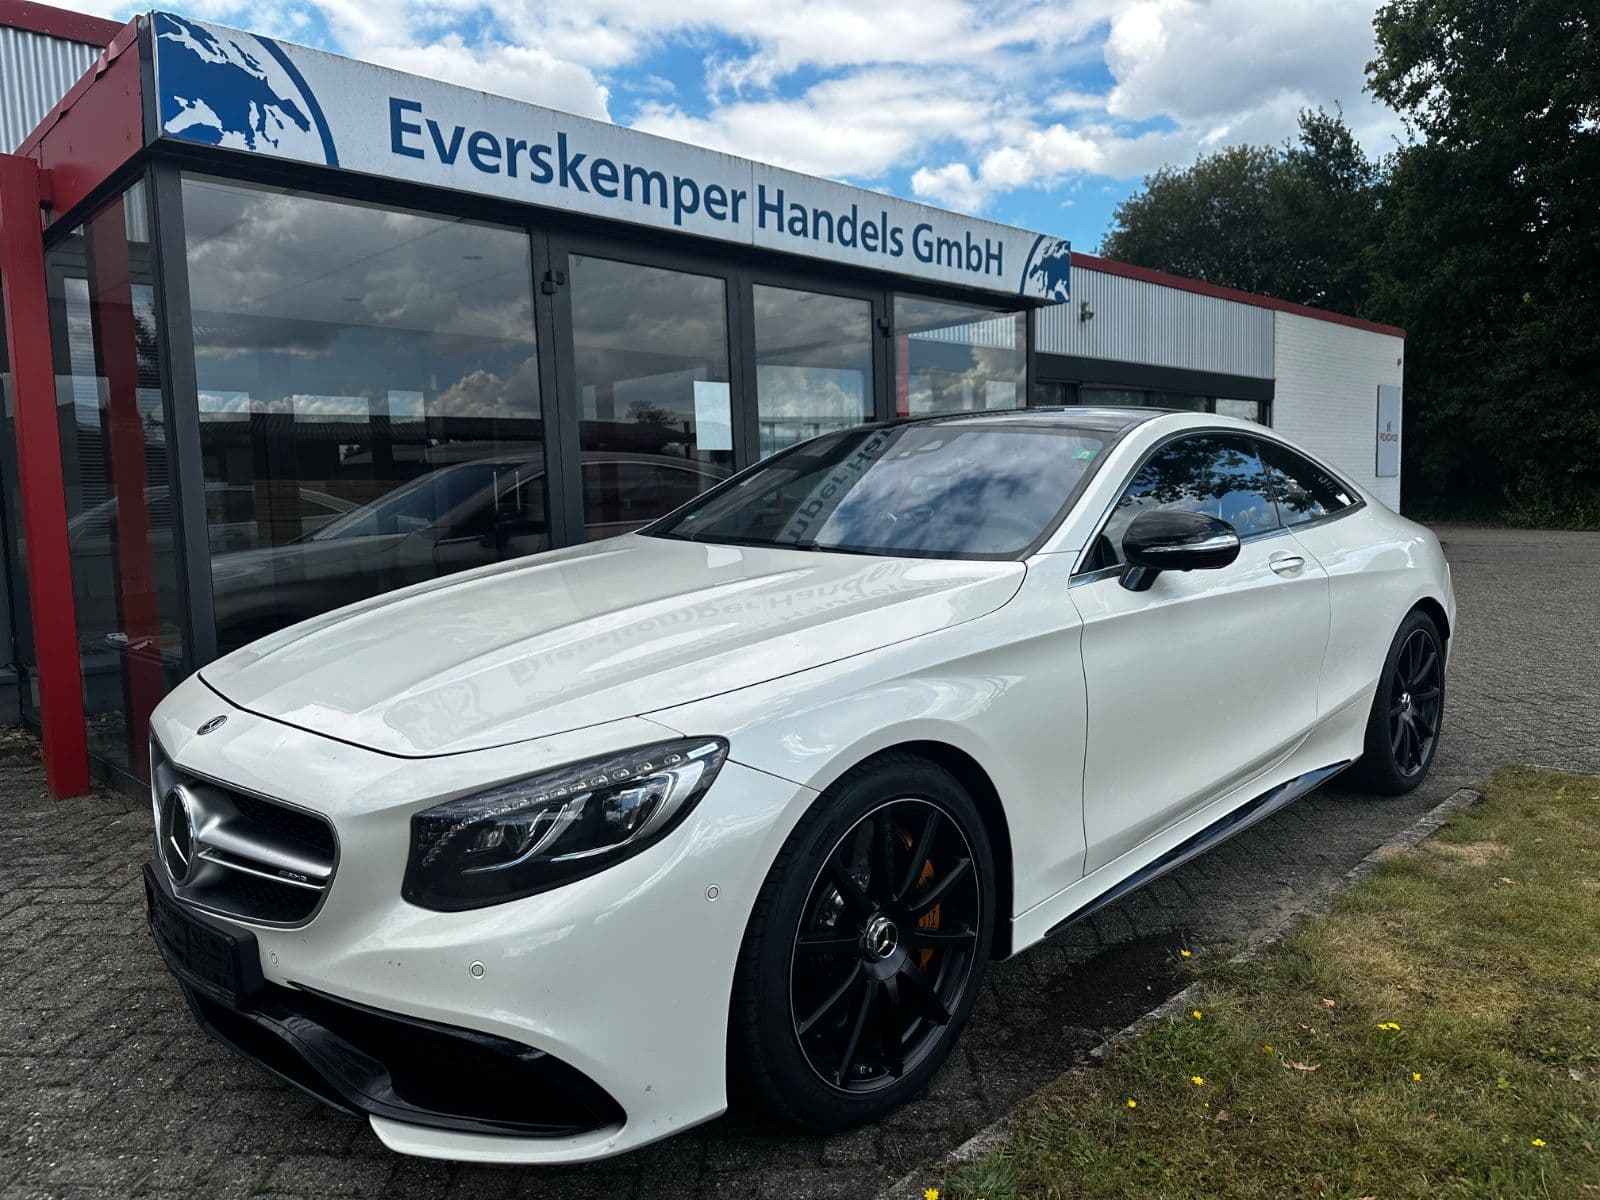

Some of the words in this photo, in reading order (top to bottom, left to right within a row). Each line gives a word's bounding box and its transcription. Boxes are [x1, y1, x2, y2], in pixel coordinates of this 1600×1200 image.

[389, 97, 747, 226] Everskemper
[757, 184, 904, 257] Handels
[912, 223, 1003, 276] GmbH
